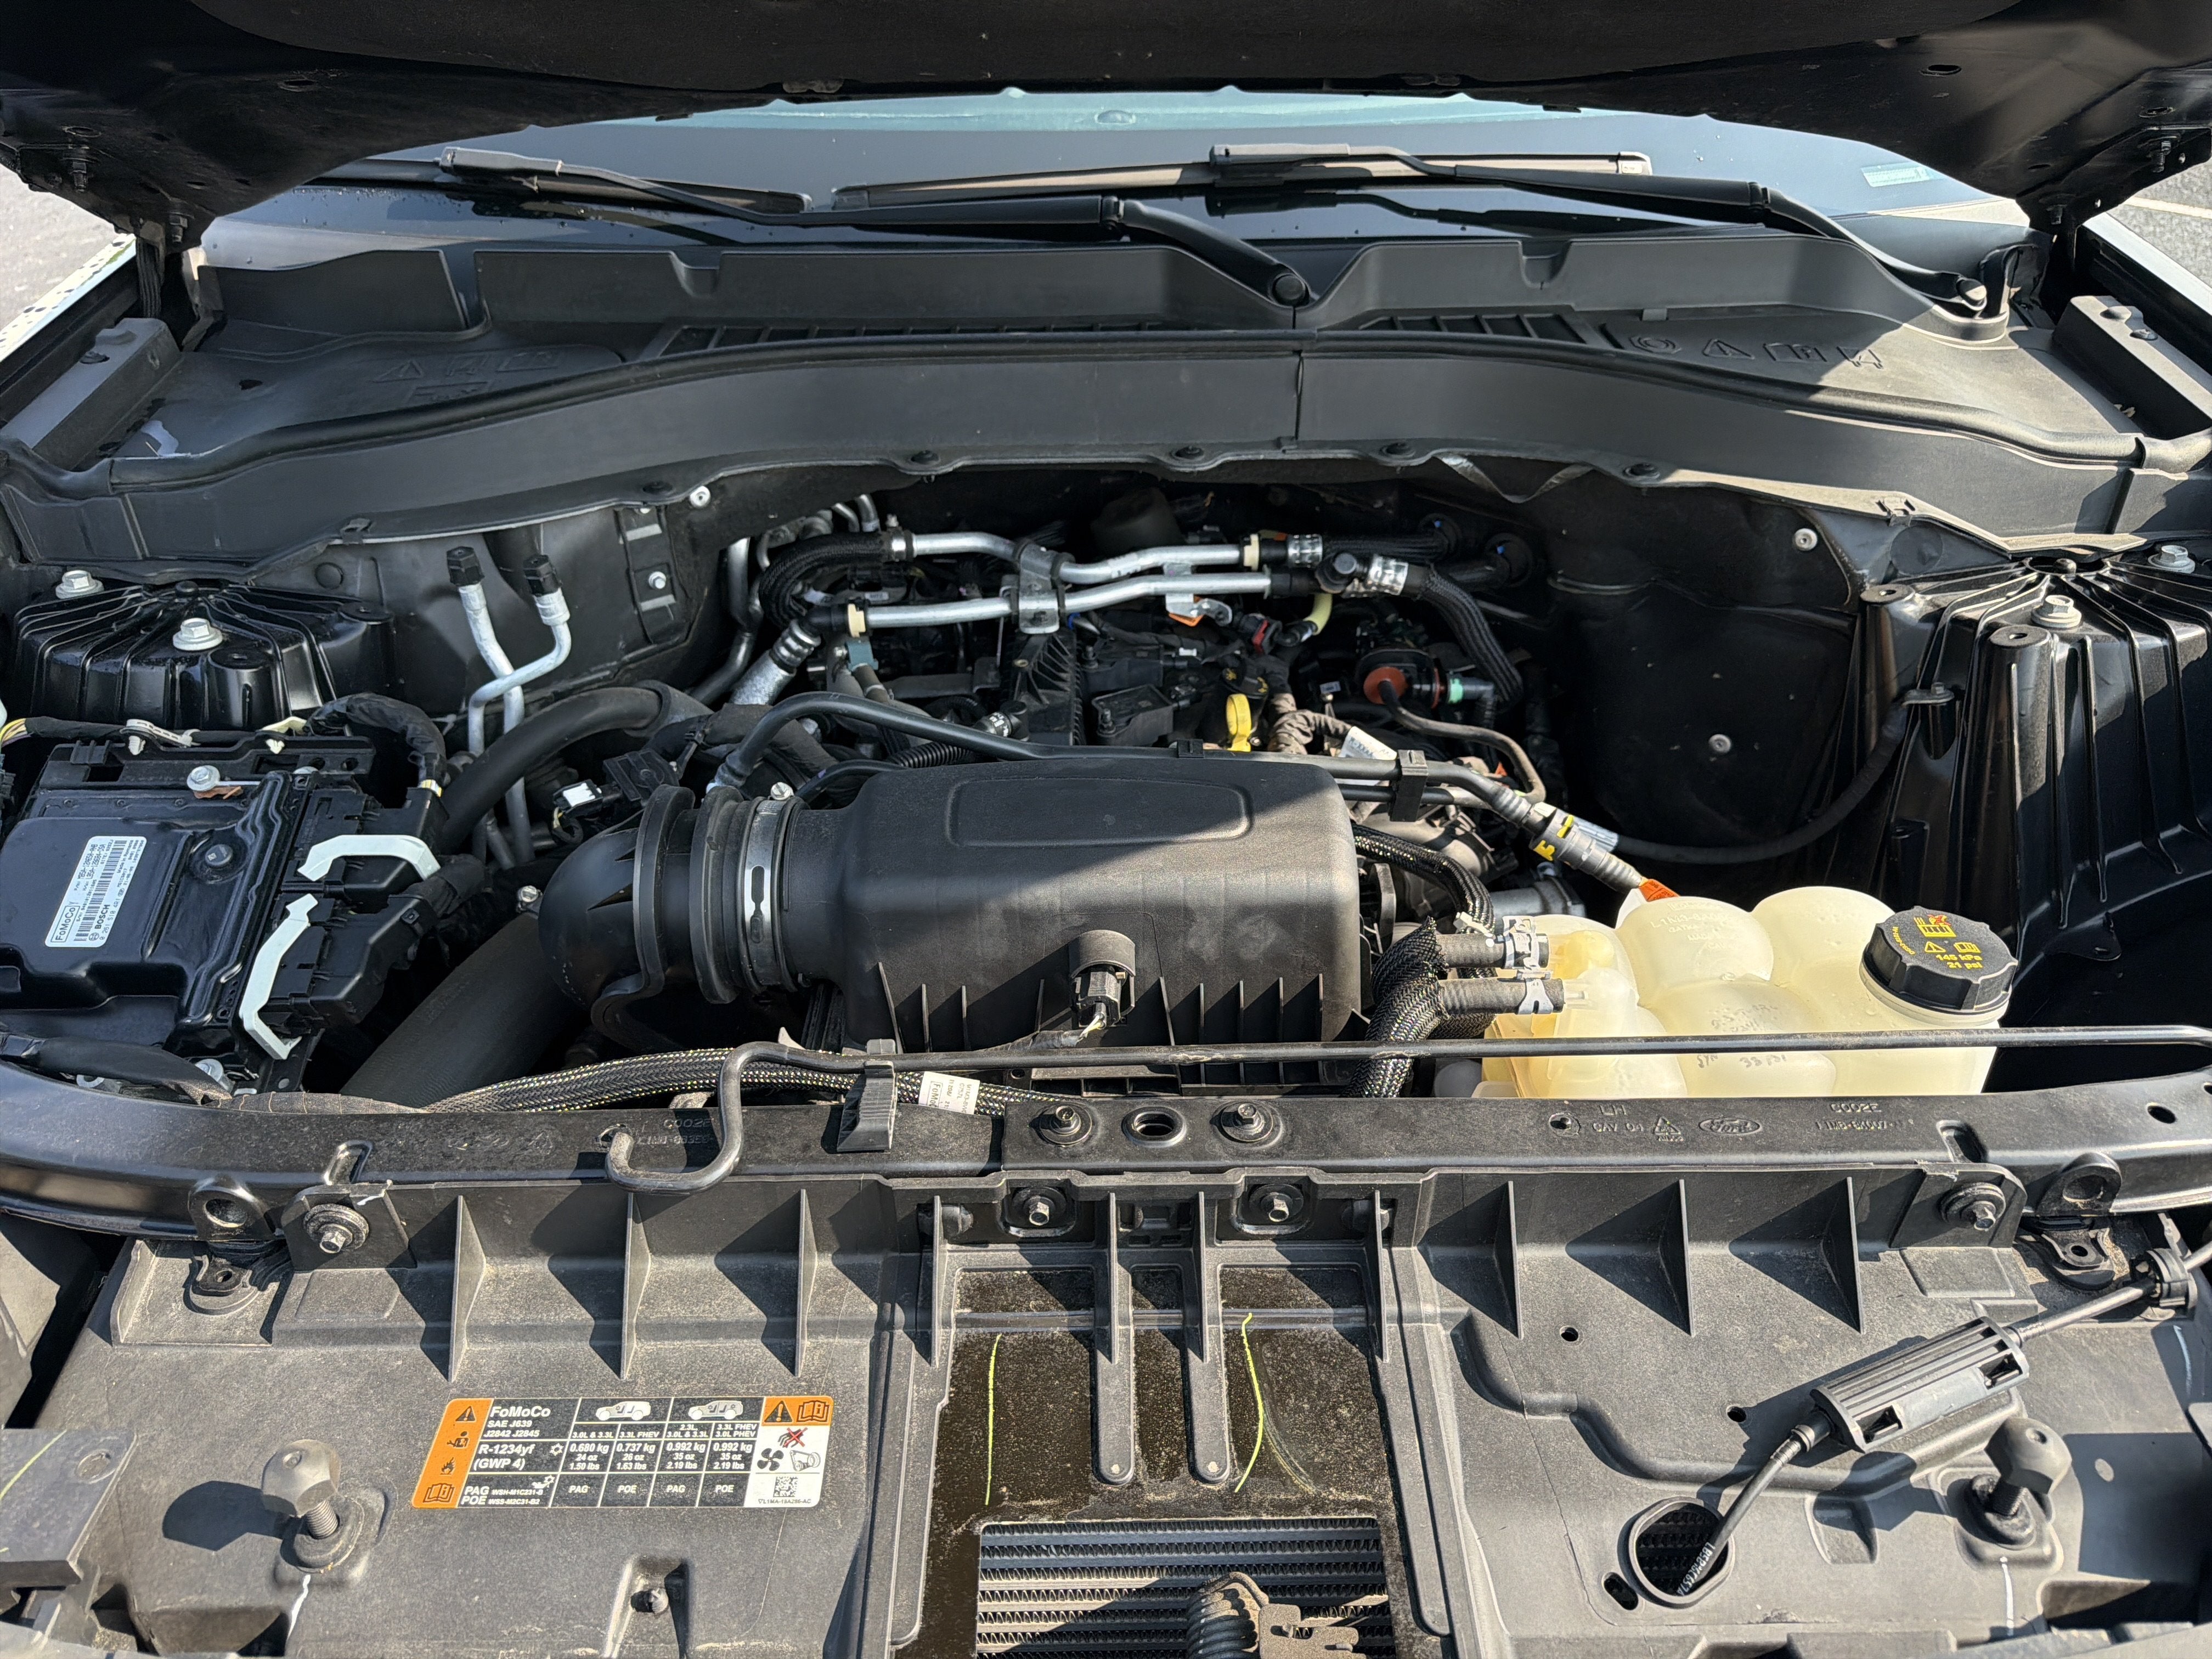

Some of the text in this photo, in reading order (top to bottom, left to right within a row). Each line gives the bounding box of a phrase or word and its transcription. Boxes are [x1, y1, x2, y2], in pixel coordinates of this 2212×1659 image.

[95, 904, 110, 929] BOSCH
[55, 907, 76, 940] FoMoCo
[929, 1083, 941, 1108] FoMoC
[490, 1406, 551, 1418] FoMoCo
[478, 1443, 535, 1456] R-1234yf
[569, 1443, 610, 1454] 0.680 kg
[616, 1443, 656, 1454] 0.737 kg
[666, 1442, 706, 1453] 0.992 kg
[713, 1442, 753, 1453] 0.992 kg
[473, 1458, 526, 1470] (GWP 4)
[569, 1462, 600, 1470] 1.50 lbs
[464, 1486, 489, 1496] PAG
[568, 1485, 588, 1493] PAG
[617, 1485, 637, 1493] POE
[715, 1485, 735, 1493] POE
[461, 1496, 487, 1505] POE
